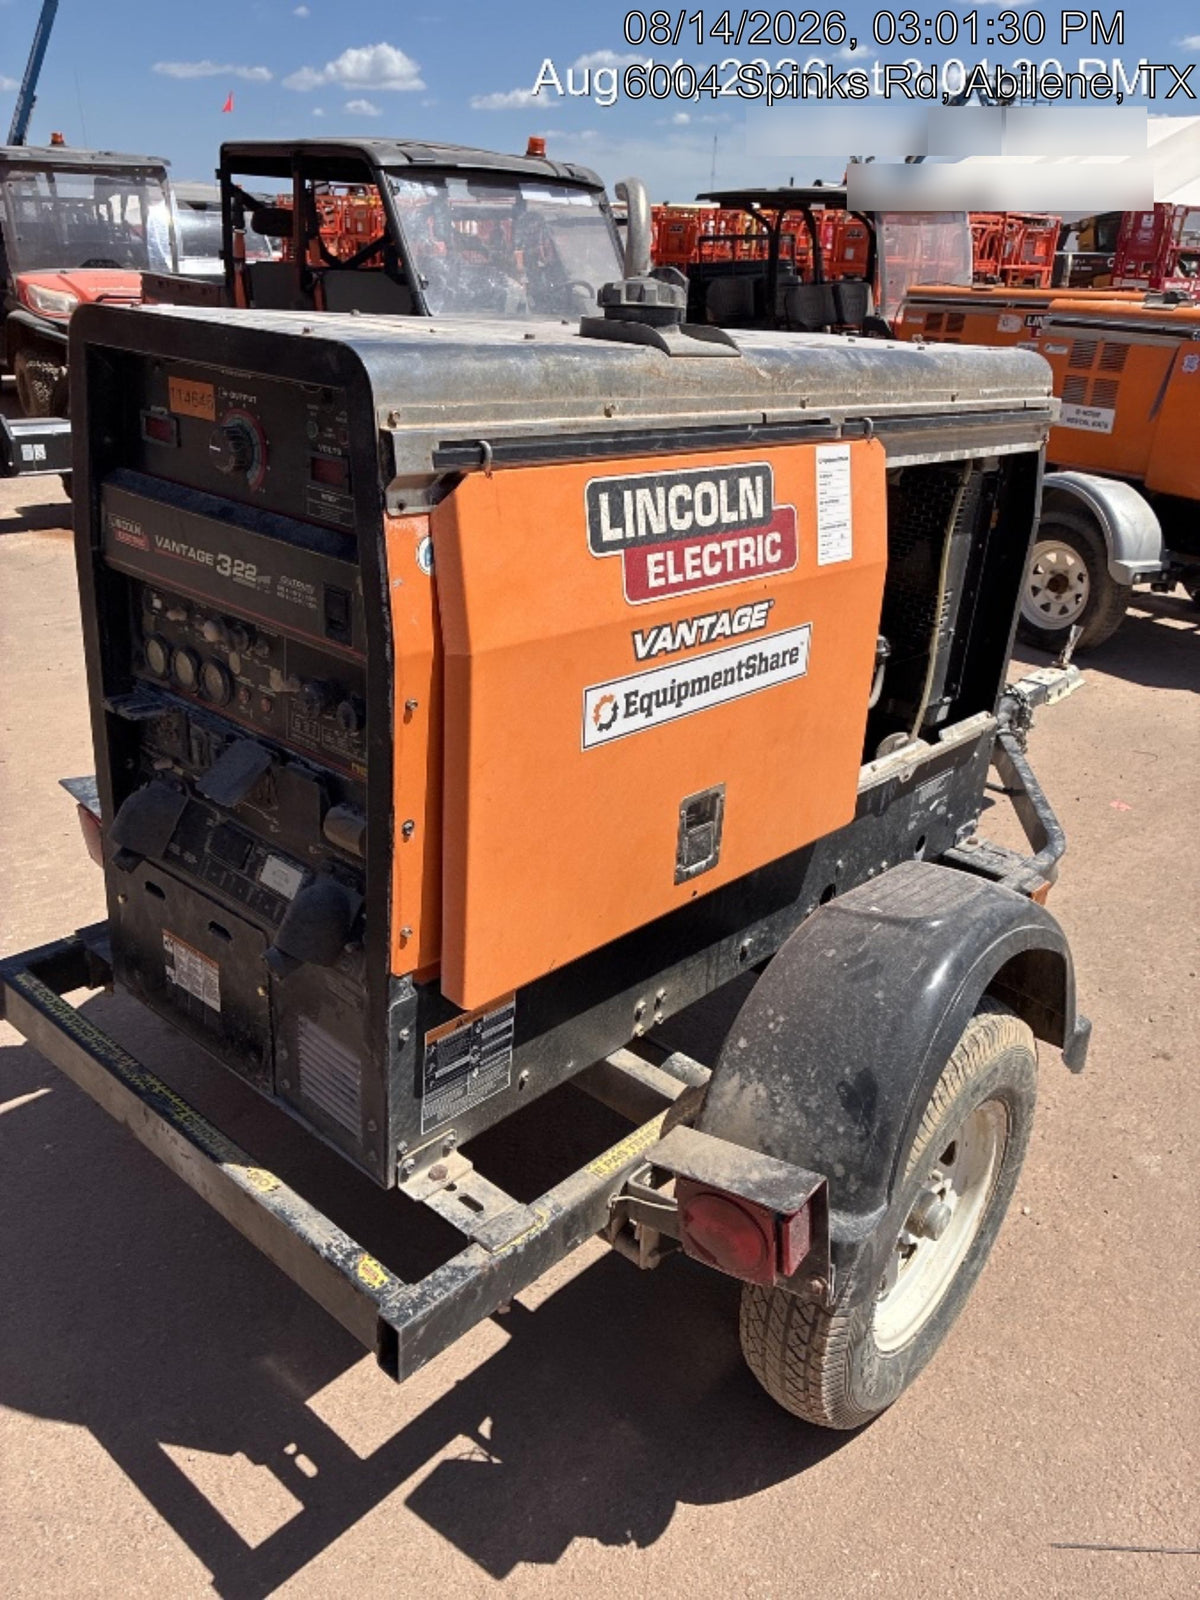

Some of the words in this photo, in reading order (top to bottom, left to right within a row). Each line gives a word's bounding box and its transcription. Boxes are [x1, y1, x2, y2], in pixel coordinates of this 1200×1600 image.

[598, 474, 764, 542] LINCOLN
[154, 534, 214, 567] VANTAGE
[216, 552, 257, 582] 322
[646, 531, 782, 589] ELECTRIC
[632, 600, 770, 661] VANTAGE
[622, 646, 801, 719] EquipmentShare
